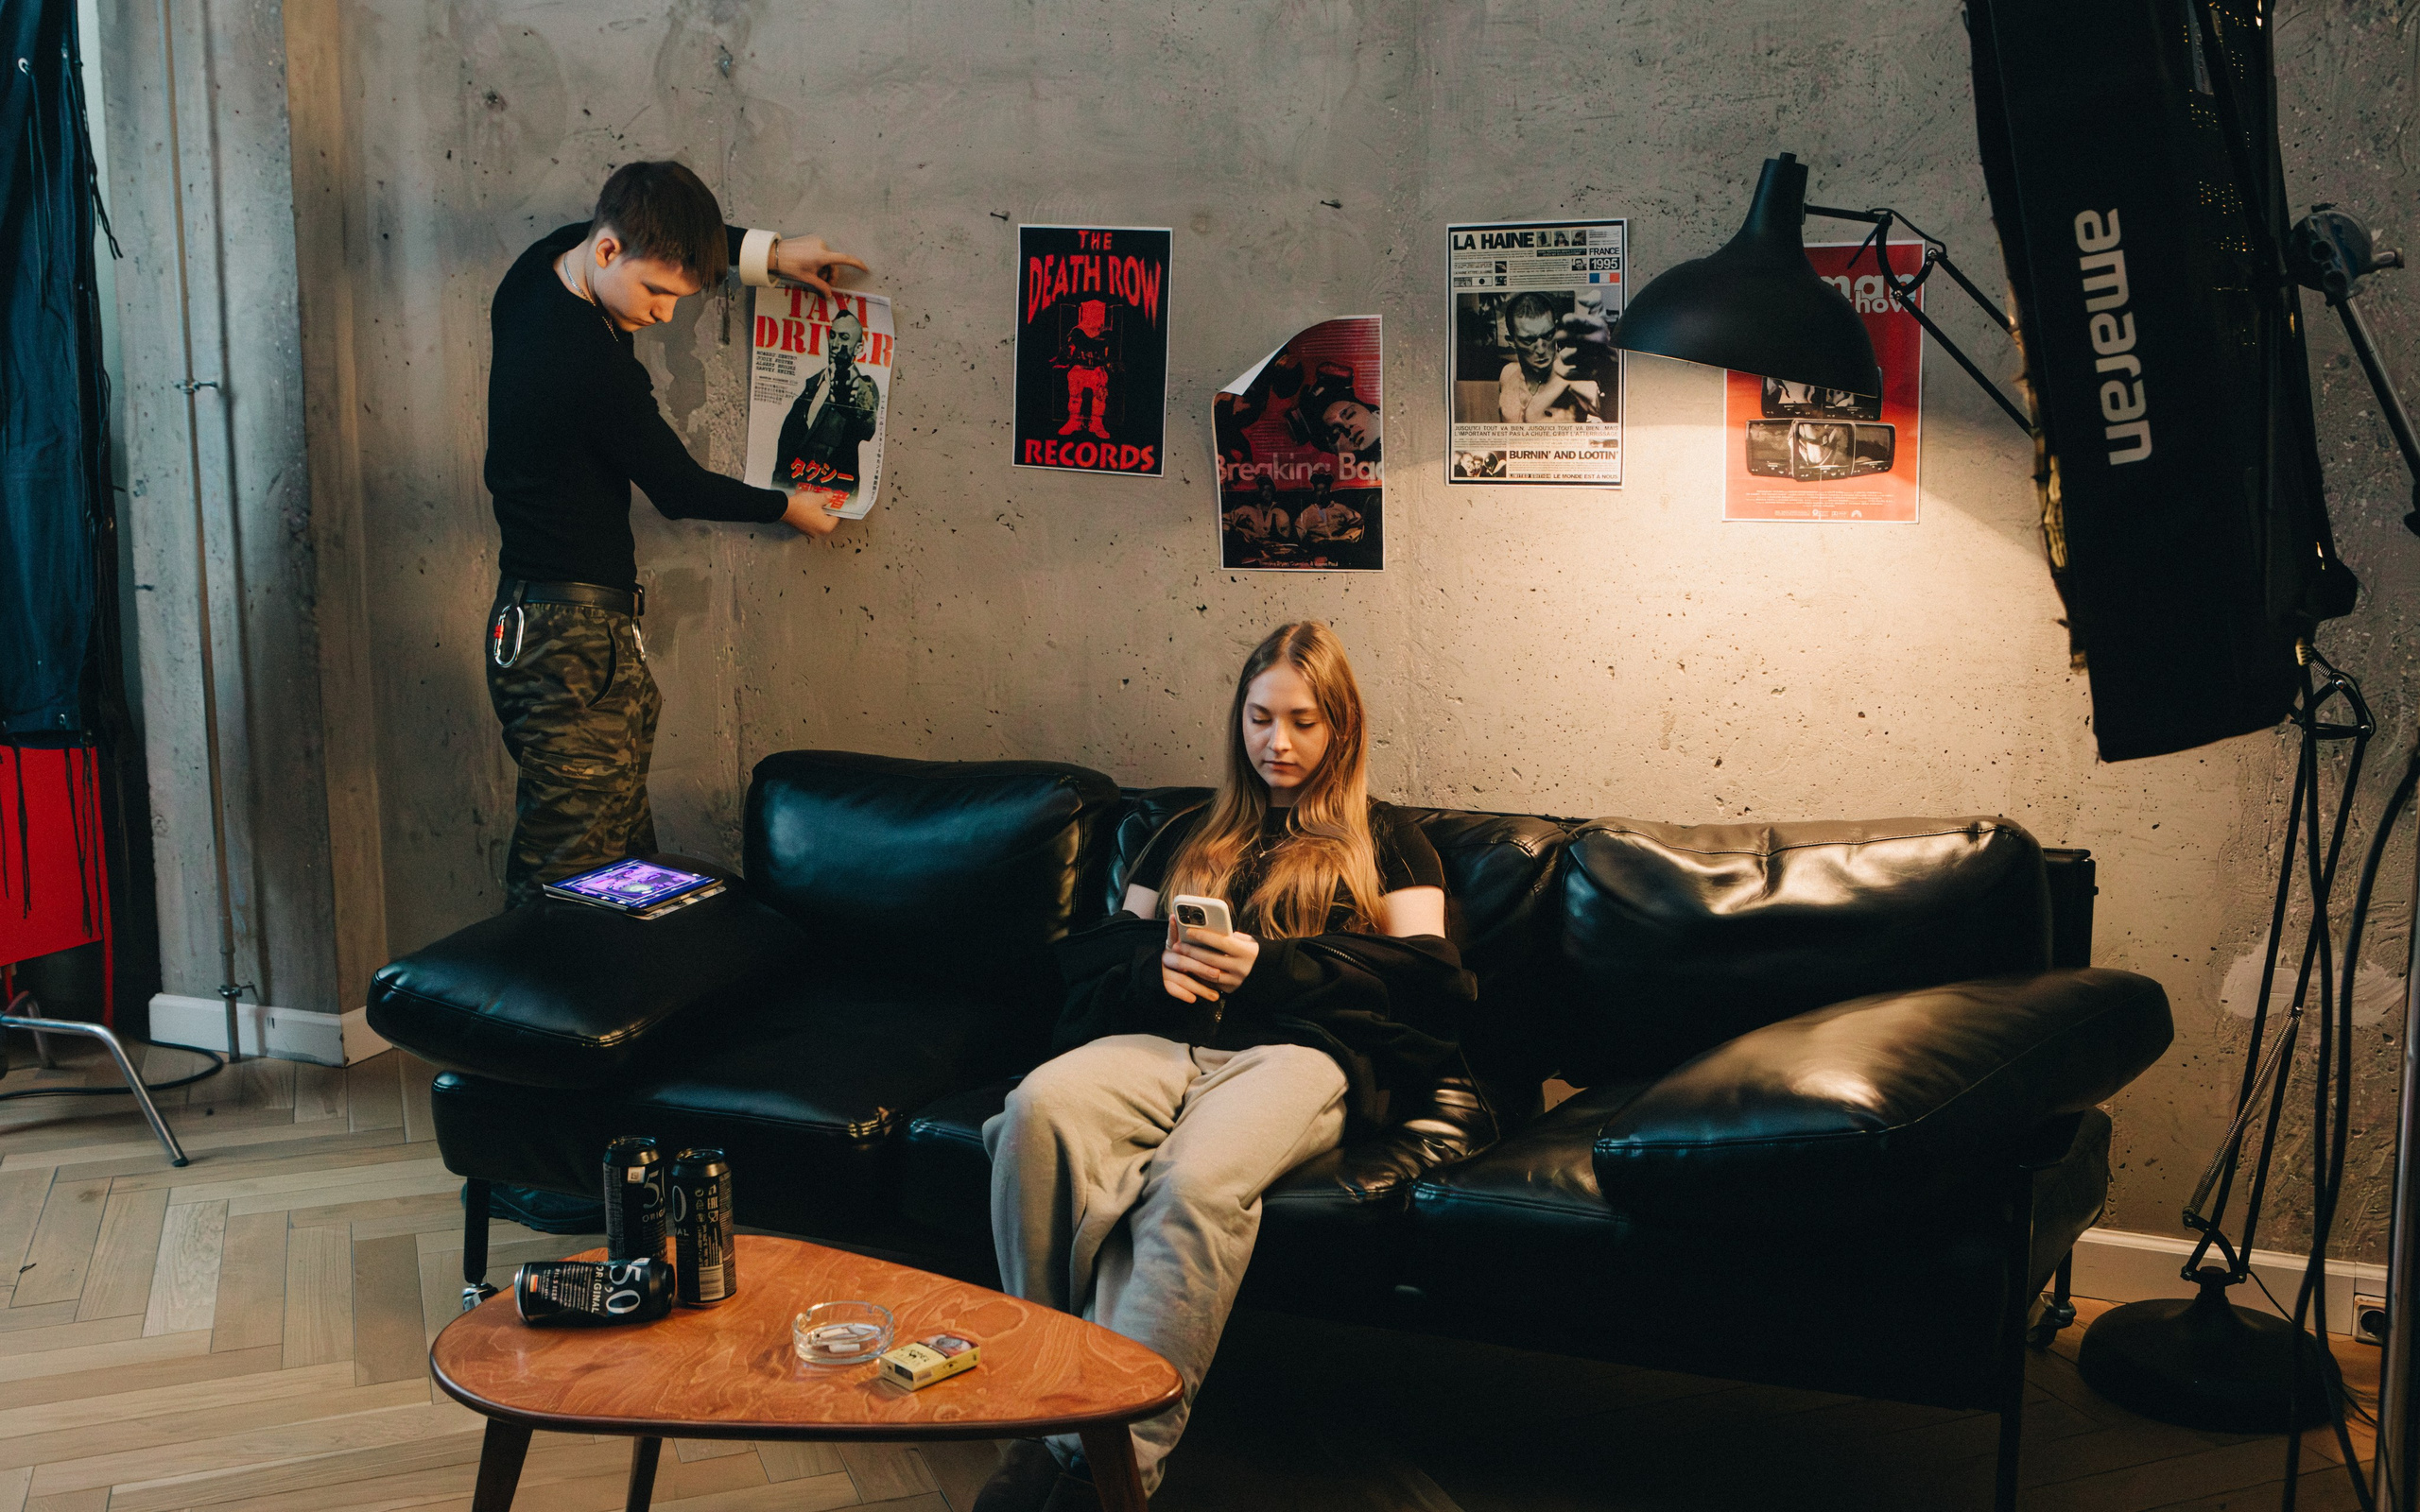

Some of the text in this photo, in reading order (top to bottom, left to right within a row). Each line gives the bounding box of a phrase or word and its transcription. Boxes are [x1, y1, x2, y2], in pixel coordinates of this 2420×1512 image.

[1078, 230, 1113, 251] THE
[1453, 232, 1534, 250] LA HAINE
[1589, 247, 1620, 255] FRANCE
[1591, 258, 1617, 269] 1995
[1027, 254, 1162, 330] DEATH ROW
[1846, 289, 1909, 314] how
[755, 315, 893, 369] DRIR
[2074, 207, 2152, 466] amaran
[1024, 438, 1155, 472] RECORDS
[1509, 450, 1618, 460] BURNIN' AND LOOTIN'
[790, 457, 855, 483] タクシー
[605, 1264, 642, 1314] 5,0
